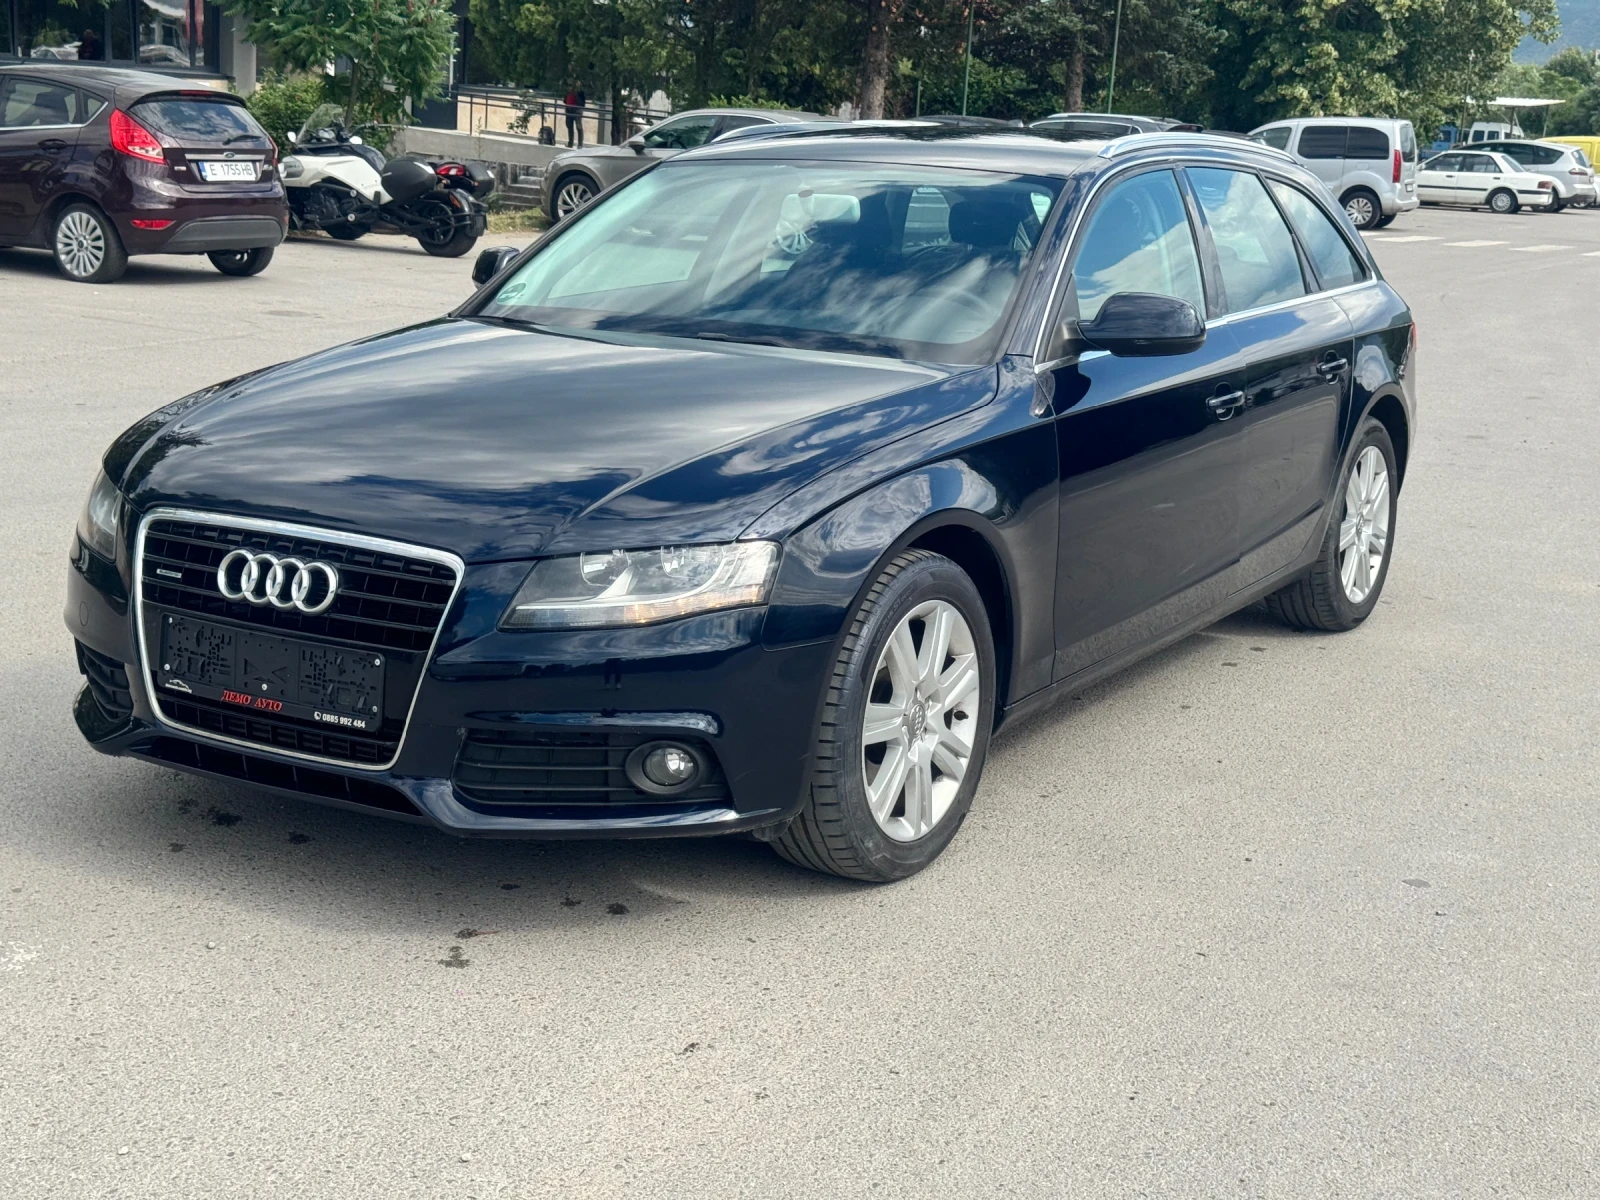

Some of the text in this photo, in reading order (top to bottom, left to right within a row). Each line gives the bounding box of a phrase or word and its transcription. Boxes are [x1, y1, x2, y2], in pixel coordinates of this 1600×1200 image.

[209, 164, 217, 176] E
[322, 713, 339, 723] 0885
[340, 716, 352, 726] 992
